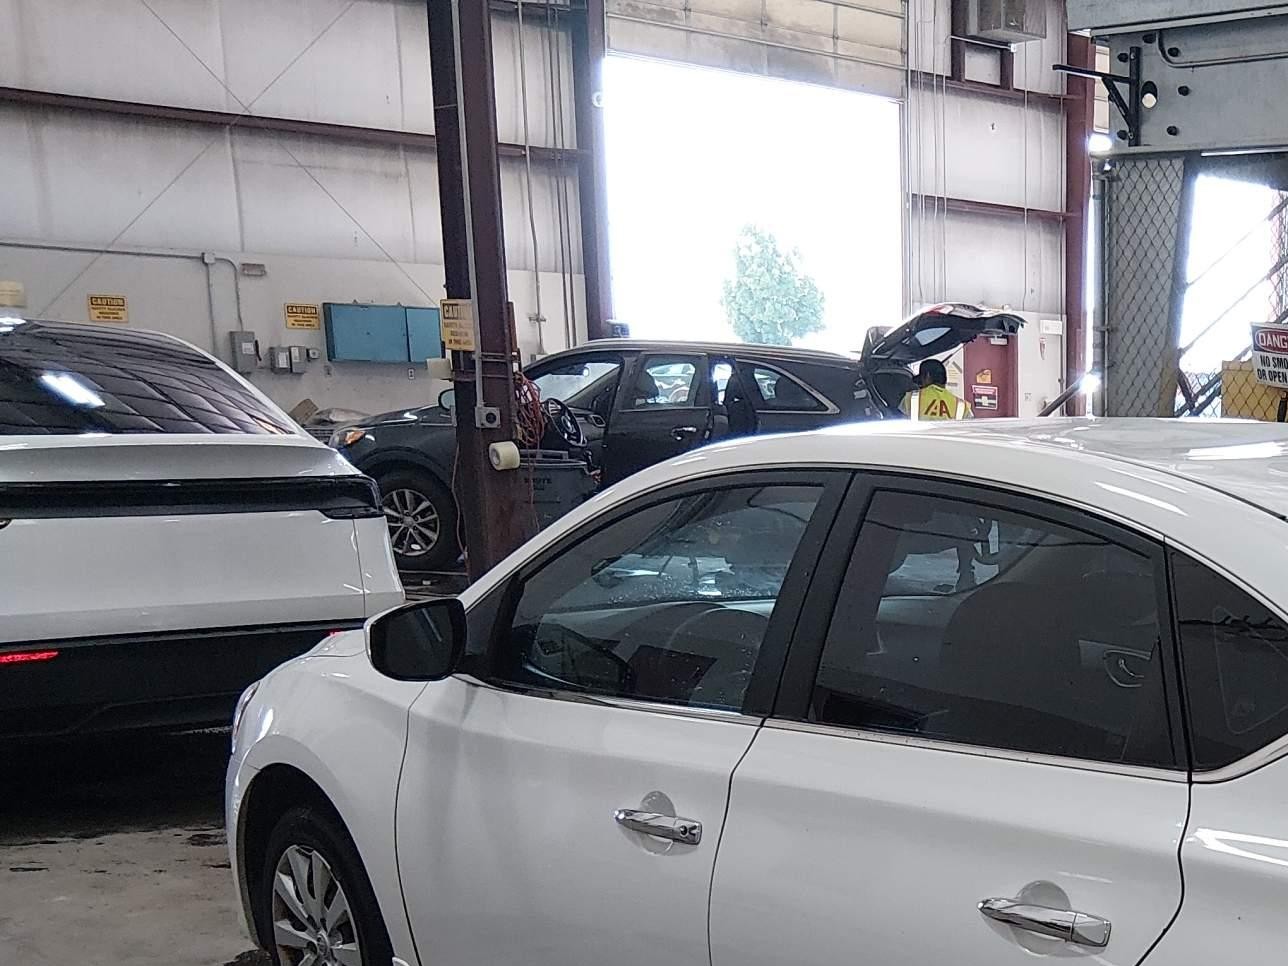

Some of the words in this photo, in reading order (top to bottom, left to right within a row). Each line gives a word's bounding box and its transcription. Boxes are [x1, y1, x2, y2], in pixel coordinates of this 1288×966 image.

[288, 306, 316, 314] CAUTION
[1260, 355, 1271, 368] NO
[1257, 368, 1268, 381] OR
[1268, 370, 1288, 384] OPEN
